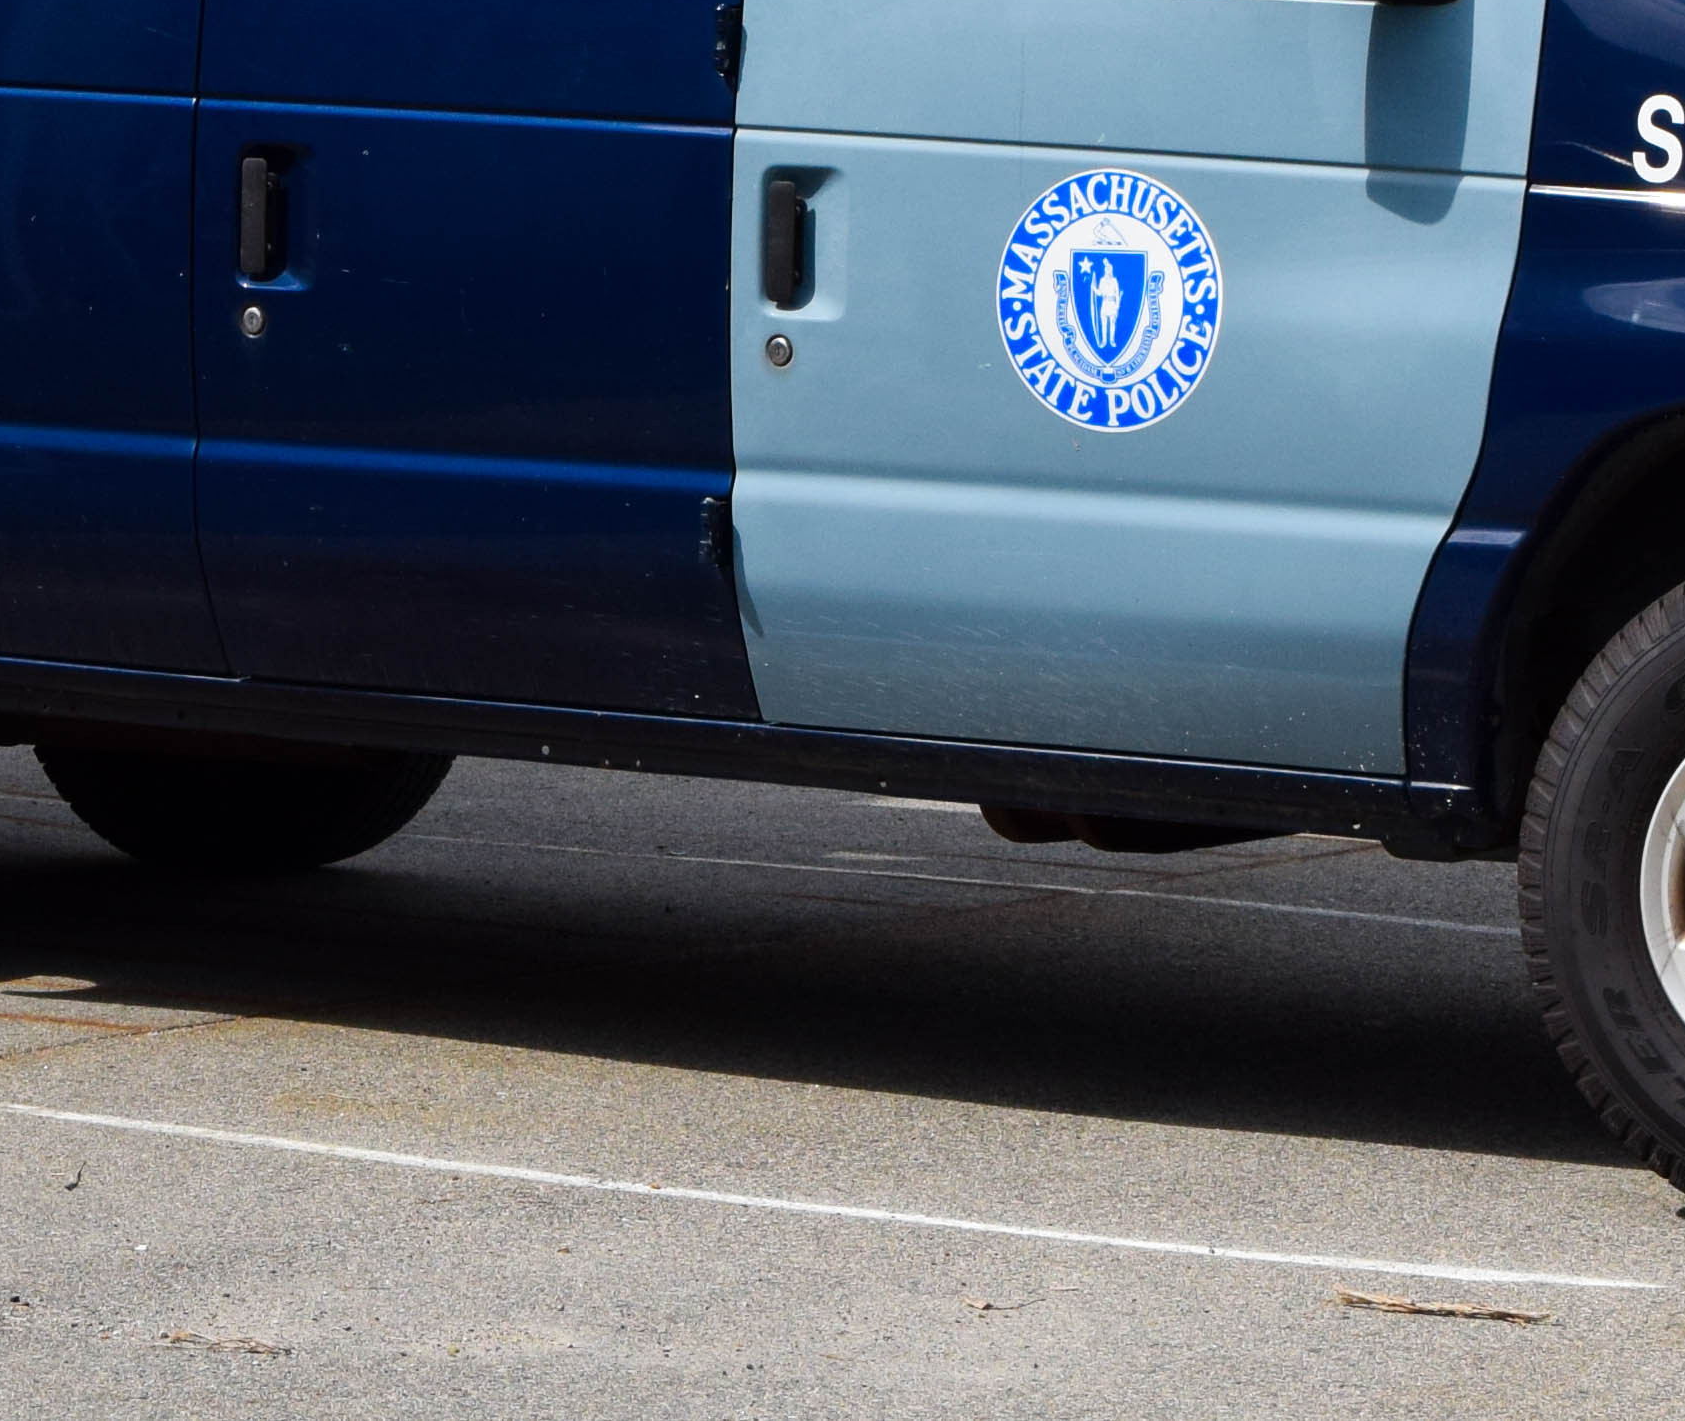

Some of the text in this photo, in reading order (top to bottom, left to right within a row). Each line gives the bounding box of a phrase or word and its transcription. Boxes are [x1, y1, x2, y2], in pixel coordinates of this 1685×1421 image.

[1002, 174, 1216, 304] MASSACHUSETTS
[1005, 313, 1097, 422] STATE
[1105, 314, 1212, 426] POLICE
